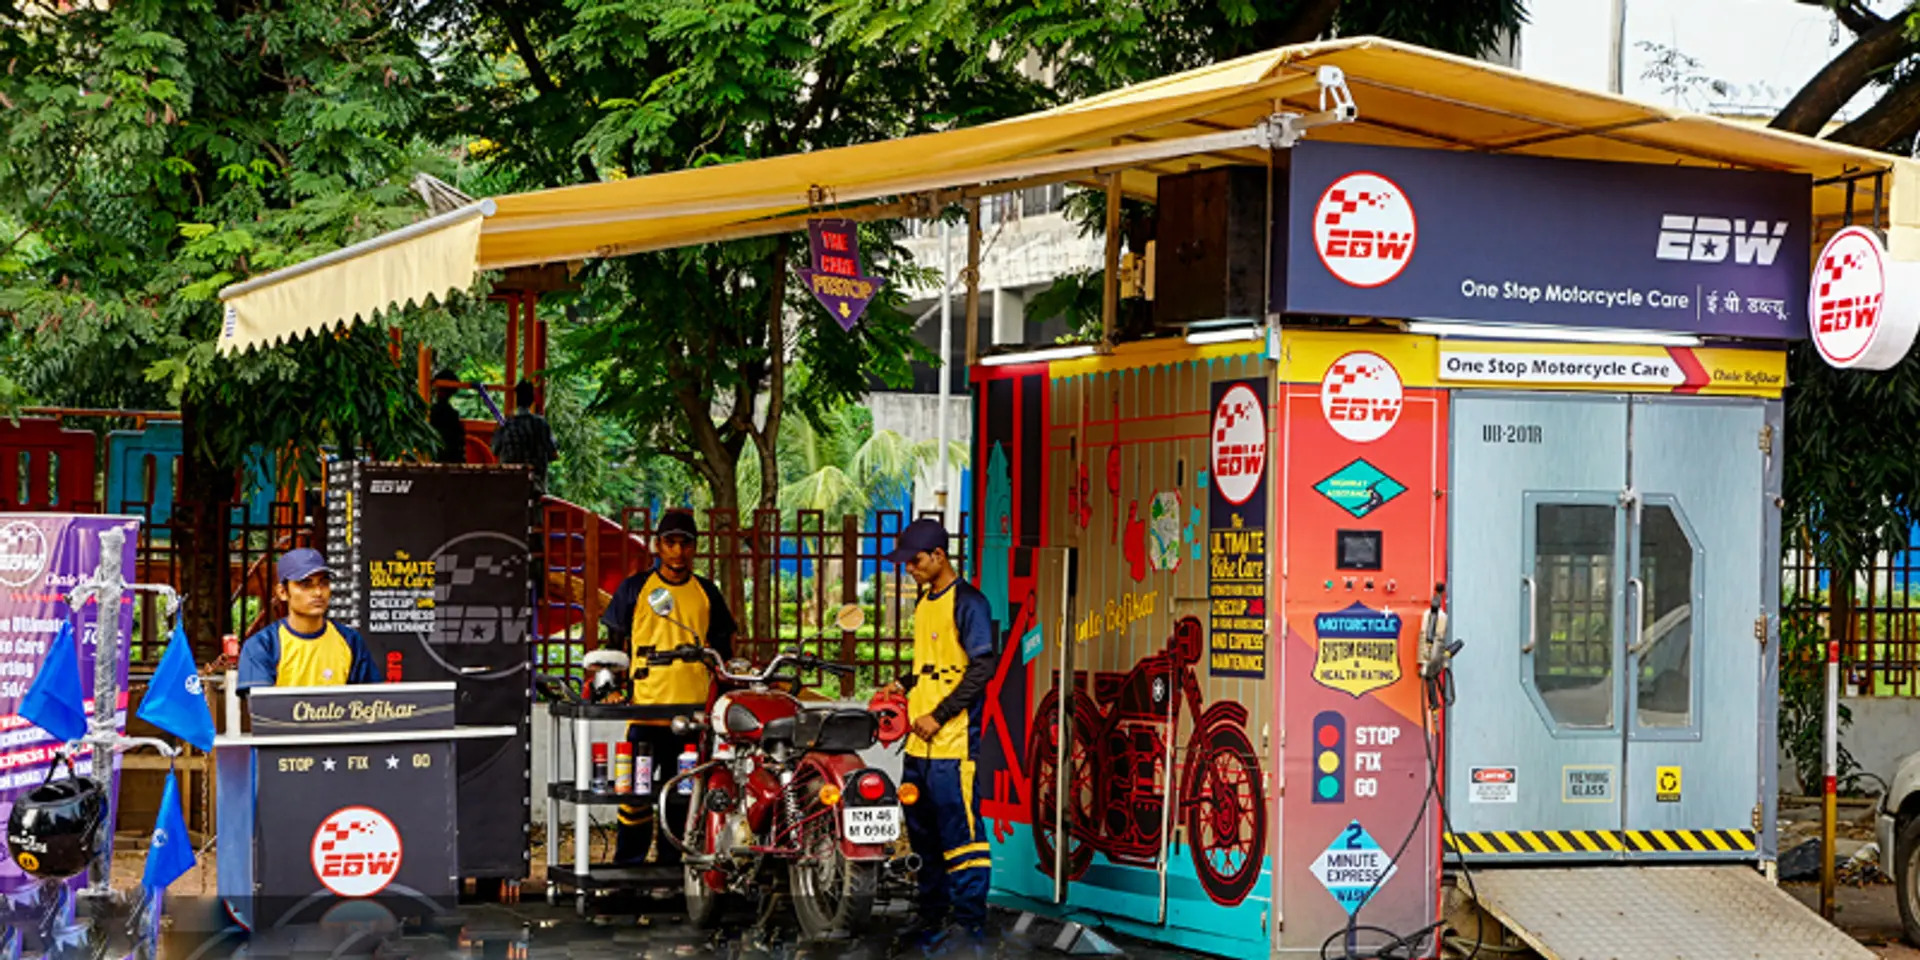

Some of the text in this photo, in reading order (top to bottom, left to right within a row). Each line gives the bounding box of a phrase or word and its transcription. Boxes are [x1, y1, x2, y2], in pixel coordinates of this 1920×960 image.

[1326, 229, 1411, 260] EBW
[1656, 214, 1789, 265] EBW
[1461, 279, 1689, 308] One Stop Motorcycle Care
[1819, 293, 1882, 333] EBW
[1447, 357, 1670, 378] One Stop Motorcycle Care
[1329, 397, 1401, 421] EBW
[1217, 444, 1264, 476] EBW
[1211, 532, 1264, 554] ULTIMATE
[370, 561, 436, 574] ULTIMATE
[1238, 555, 1263, 577] Care
[403, 574, 435, 588] Care
[1212, 599, 1247, 615] CHECKUP
[13, 617, 67, 632] Ultimat
[370, 622, 436, 632] MAINTENANCE
[1318, 617, 1398, 632] MOTORCYCLE
[1212, 633, 1264, 650] AND EXPRESS
[1323, 641, 1393, 663] SYSTEM CHECKUP
[1212, 654, 1264, 671] MAINTENANCE
[1320, 669, 1393, 681] HEALTH RATING
[293, 700, 416, 723] Chalo Befikar
[1355, 726, 1400, 745] STOP
[278, 754, 430, 772] STOP FIX GO
[1354, 752, 1382, 771] FIX
[1354, 778, 1377, 797] GO
[1572, 785, 1604, 796] GLASS
[1346, 823, 1362, 849] 2
[322, 852, 398, 877] EBW
[1327, 854, 1378, 867] MINUTE
[1327, 869, 1381, 882] EXPRESS
